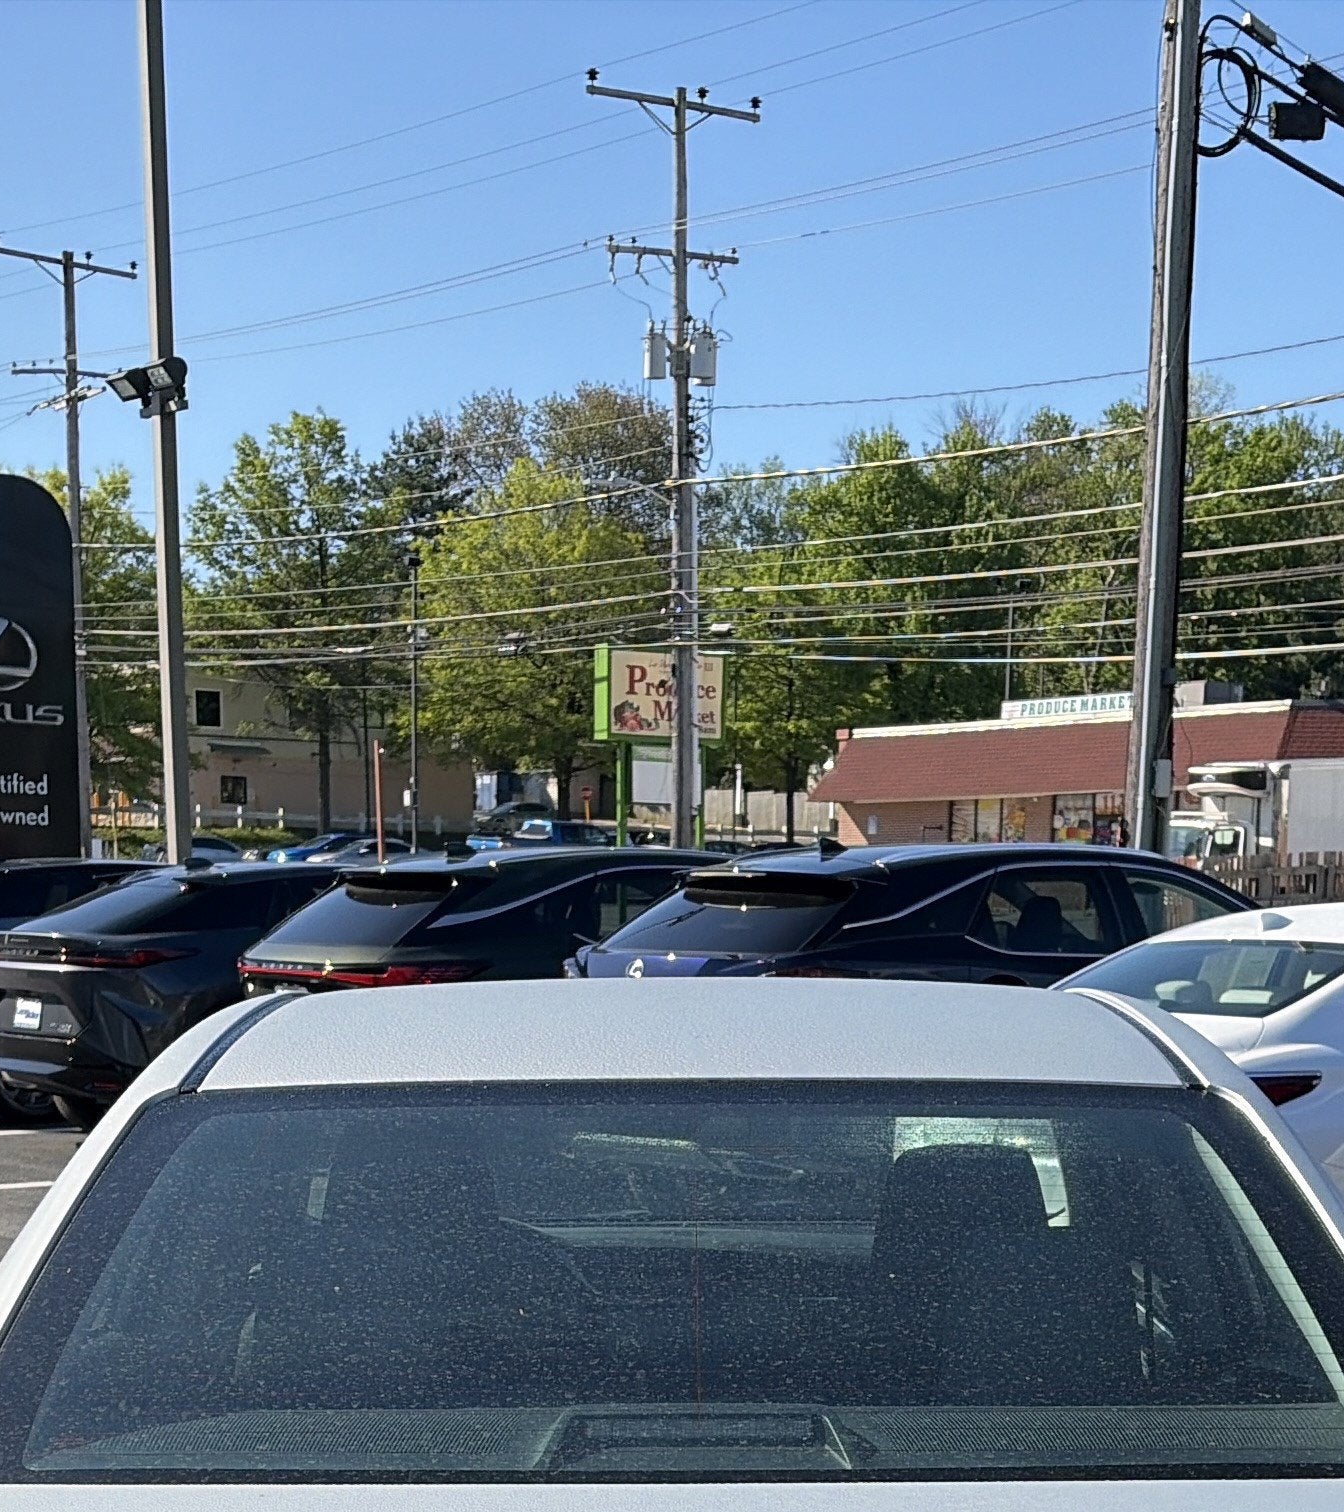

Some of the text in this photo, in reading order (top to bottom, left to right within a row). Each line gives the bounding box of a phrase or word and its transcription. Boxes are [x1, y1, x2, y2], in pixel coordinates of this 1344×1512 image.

[625, 664, 717, 700] Proce
[653, 699, 716, 725] Met
[1020, 694, 1135, 716] PRODUCE MARKET
